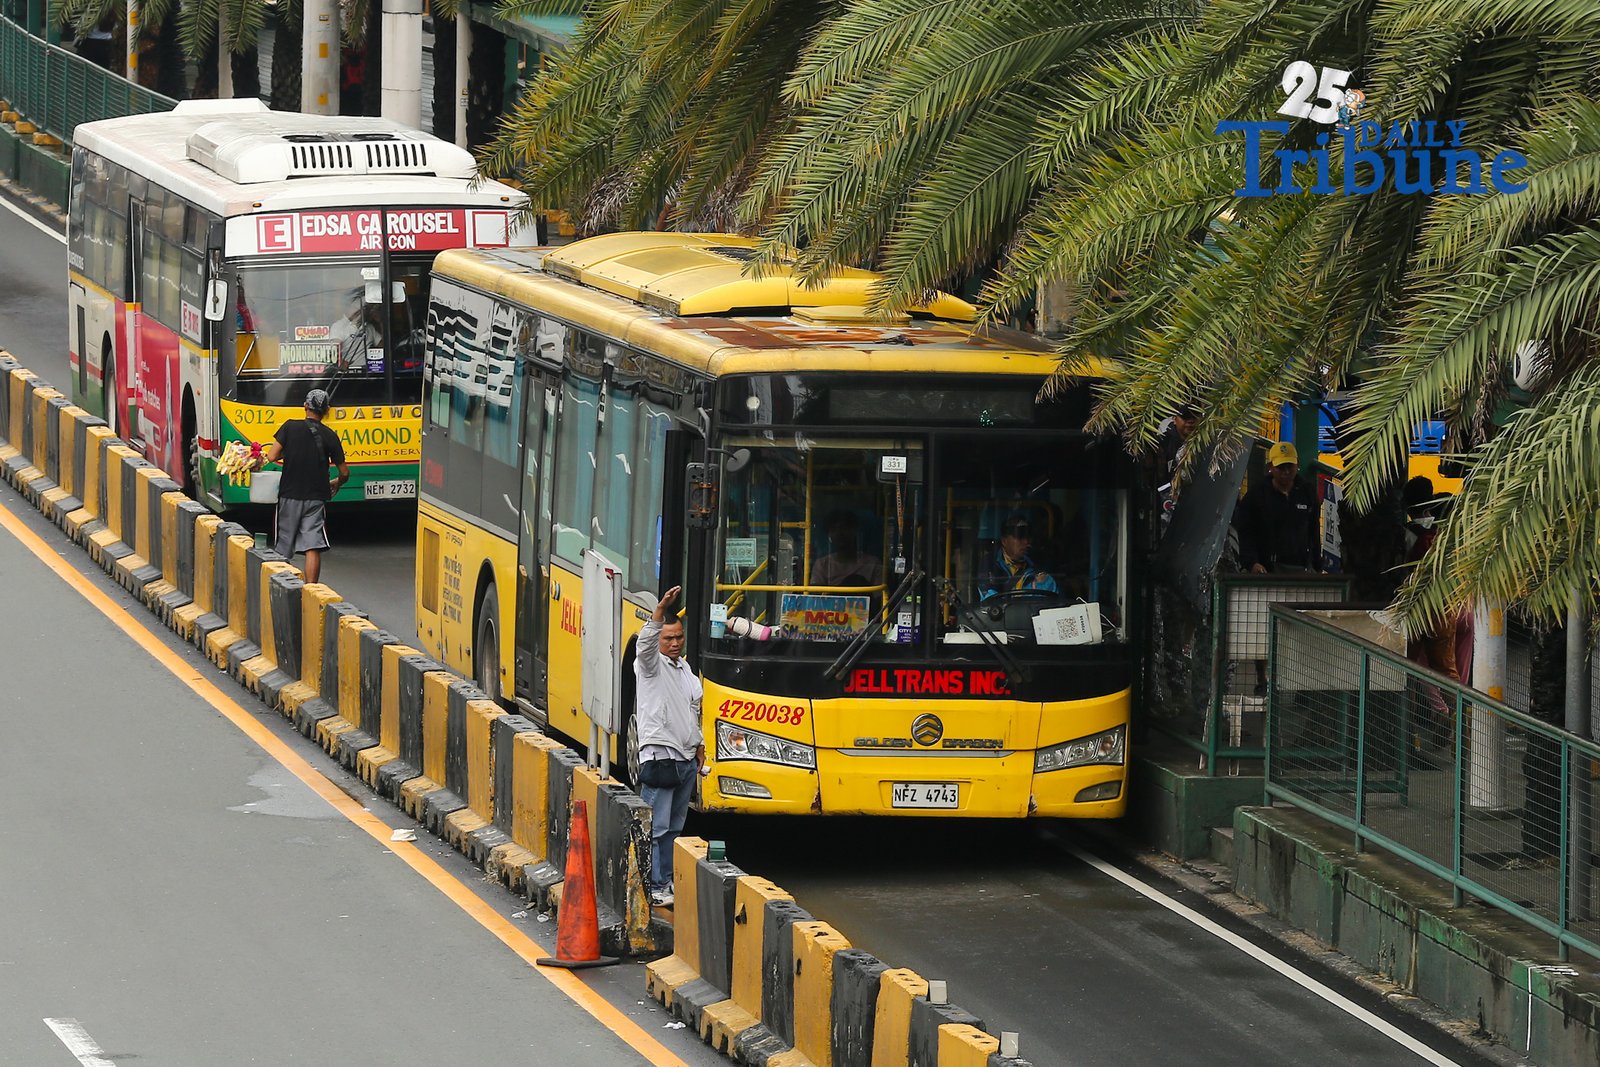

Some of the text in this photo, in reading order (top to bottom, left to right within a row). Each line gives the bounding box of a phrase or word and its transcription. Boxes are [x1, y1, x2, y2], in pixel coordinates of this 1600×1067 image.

[264, 213, 459, 247] E EDSA CAROUSEL
[281, 345, 338, 364] MONUMENTO
[288, 365, 325, 374] MCU
[235, 409, 274, 424] 3012
[336, 427, 411, 446] AMOND
[344, 449, 390, 457] RANSIT
[366, 484, 414, 495] NEM 2732
[561, 597, 576, 636] JELL
[805, 611, 849, 625] MCU
[844, 670, 1011, 695] JELL TRANS INC.
[718, 700, 804, 726] 4720038
[854, 737, 1004, 749] GOLDEN DRAGON
[895, 788, 957, 803] NFZ 4743
